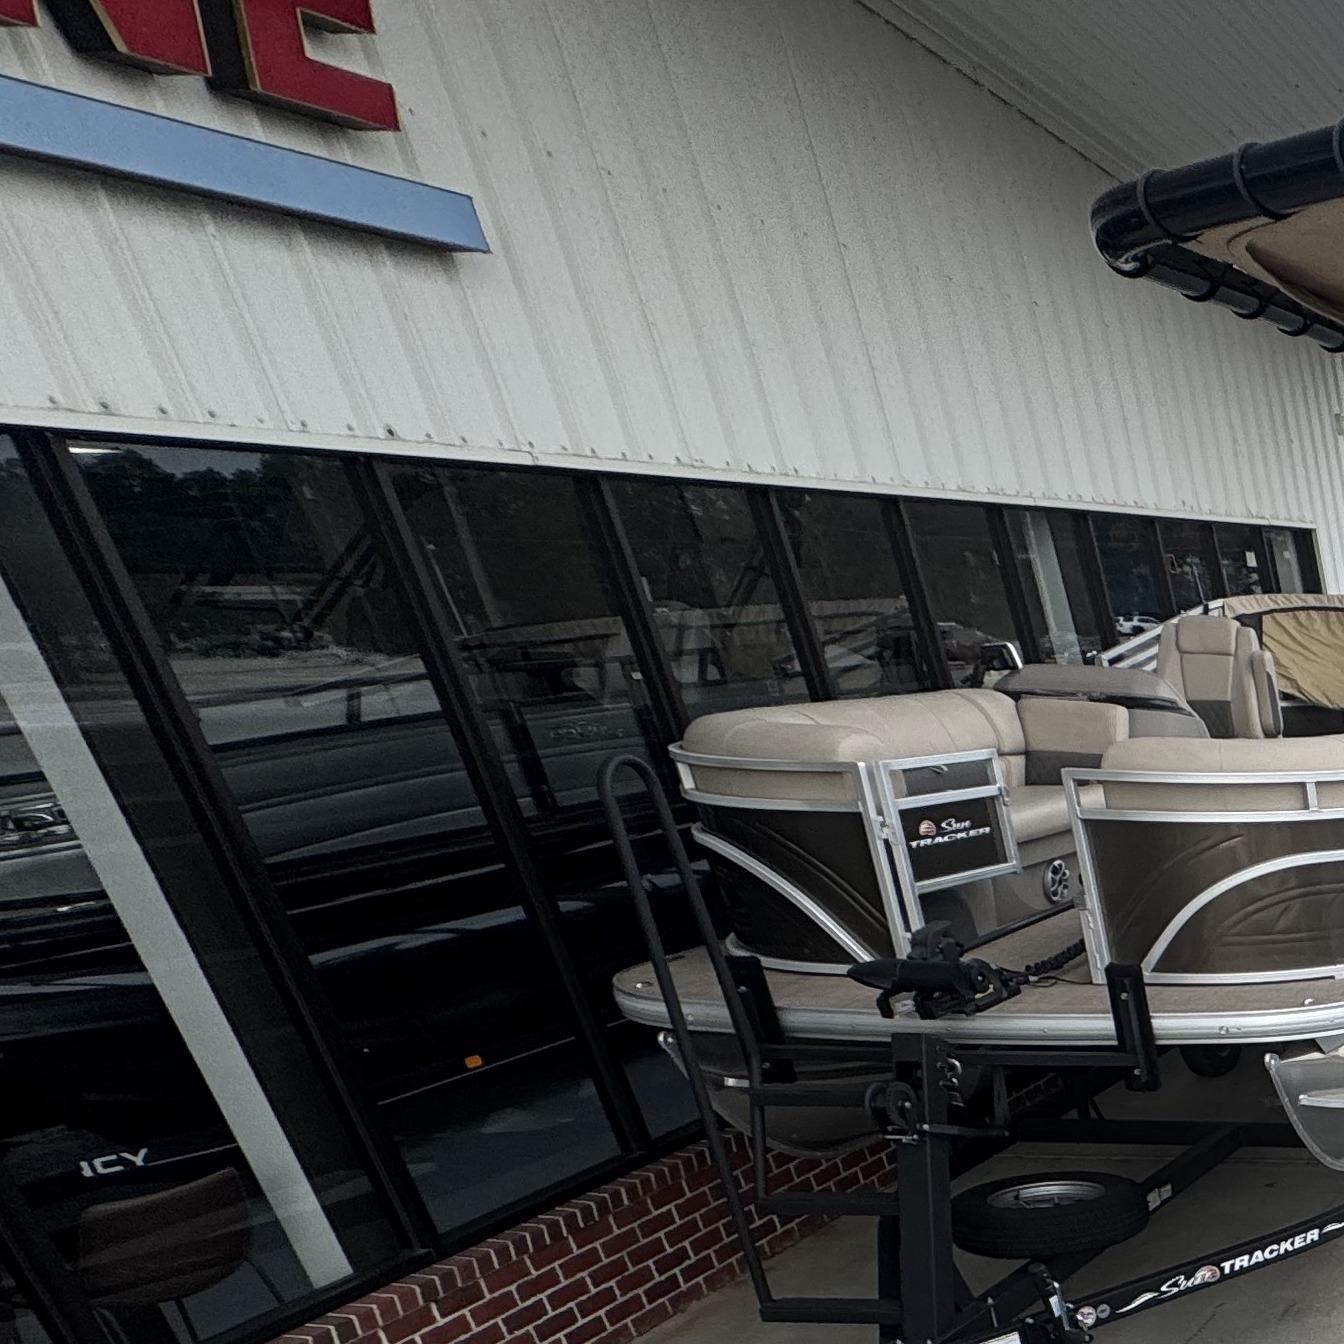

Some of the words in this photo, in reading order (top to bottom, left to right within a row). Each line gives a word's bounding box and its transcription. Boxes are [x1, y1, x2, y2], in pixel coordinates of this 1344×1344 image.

[939, 818, 972, 833] Sun
[909, 827, 991, 848] TRACKER
[1157, 1271, 1216, 1299] Sun
[1220, 1228, 1320, 1275] TRACKER
